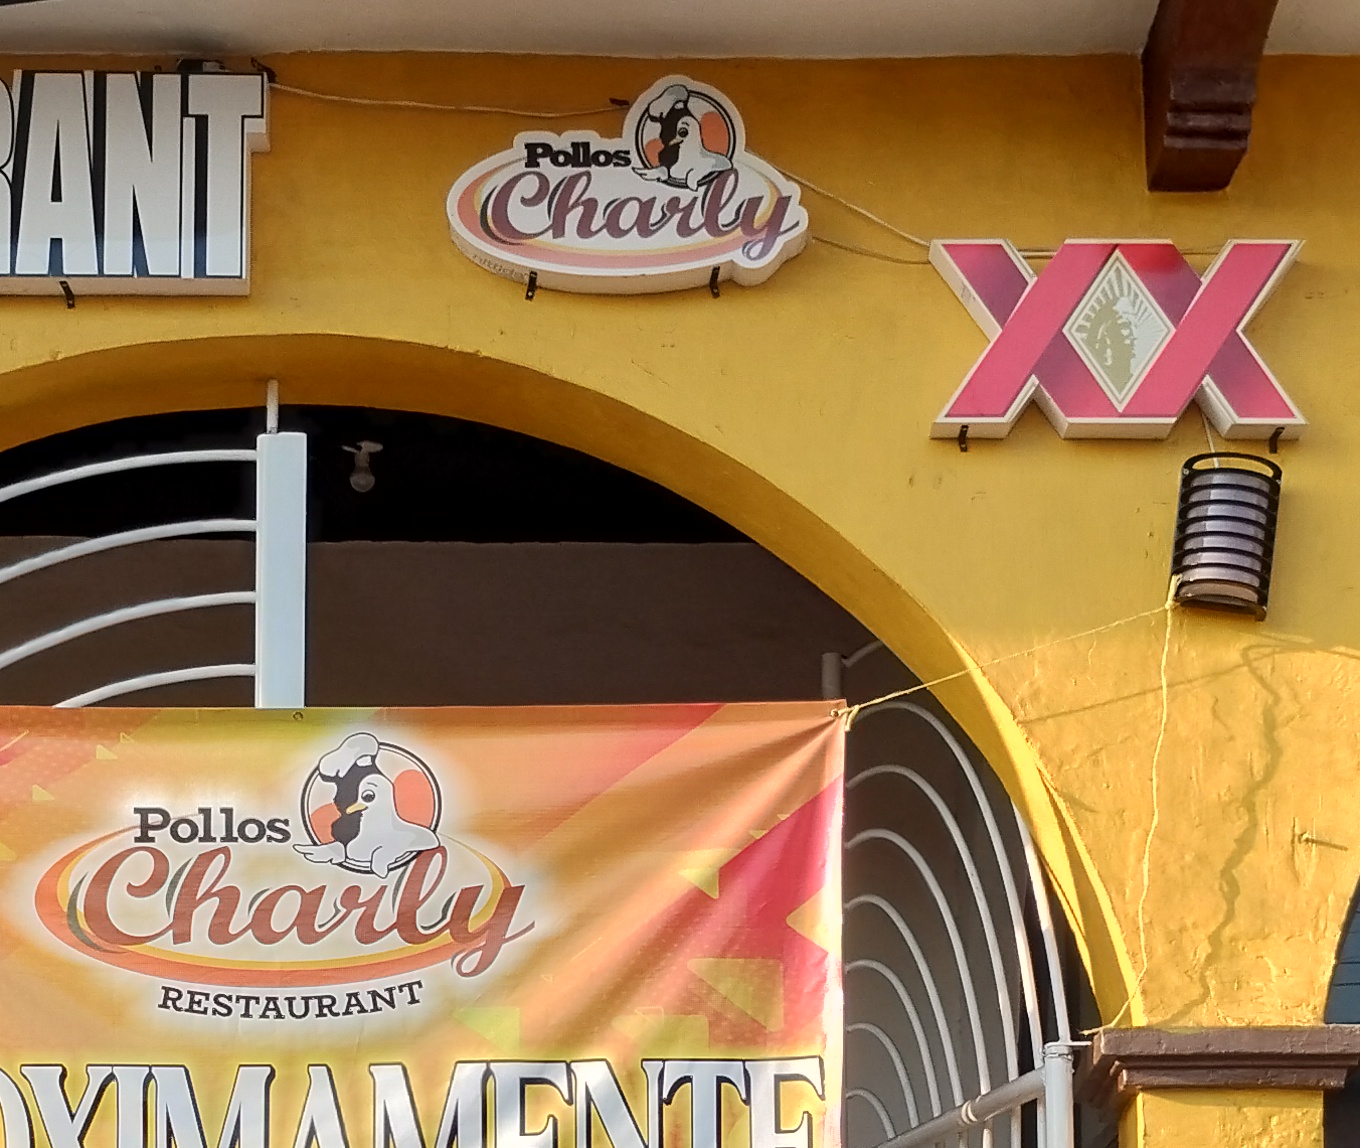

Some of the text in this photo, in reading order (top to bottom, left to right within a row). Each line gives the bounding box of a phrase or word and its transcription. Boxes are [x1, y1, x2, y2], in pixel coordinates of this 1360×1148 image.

[524, 142, 632, 168] Pollos
[482, 170, 800, 261] Charly
[133, 806, 292, 844] Pollos
[68, 846, 537, 979] Charly
[157, 979, 424, 1021] RESTAURANT
